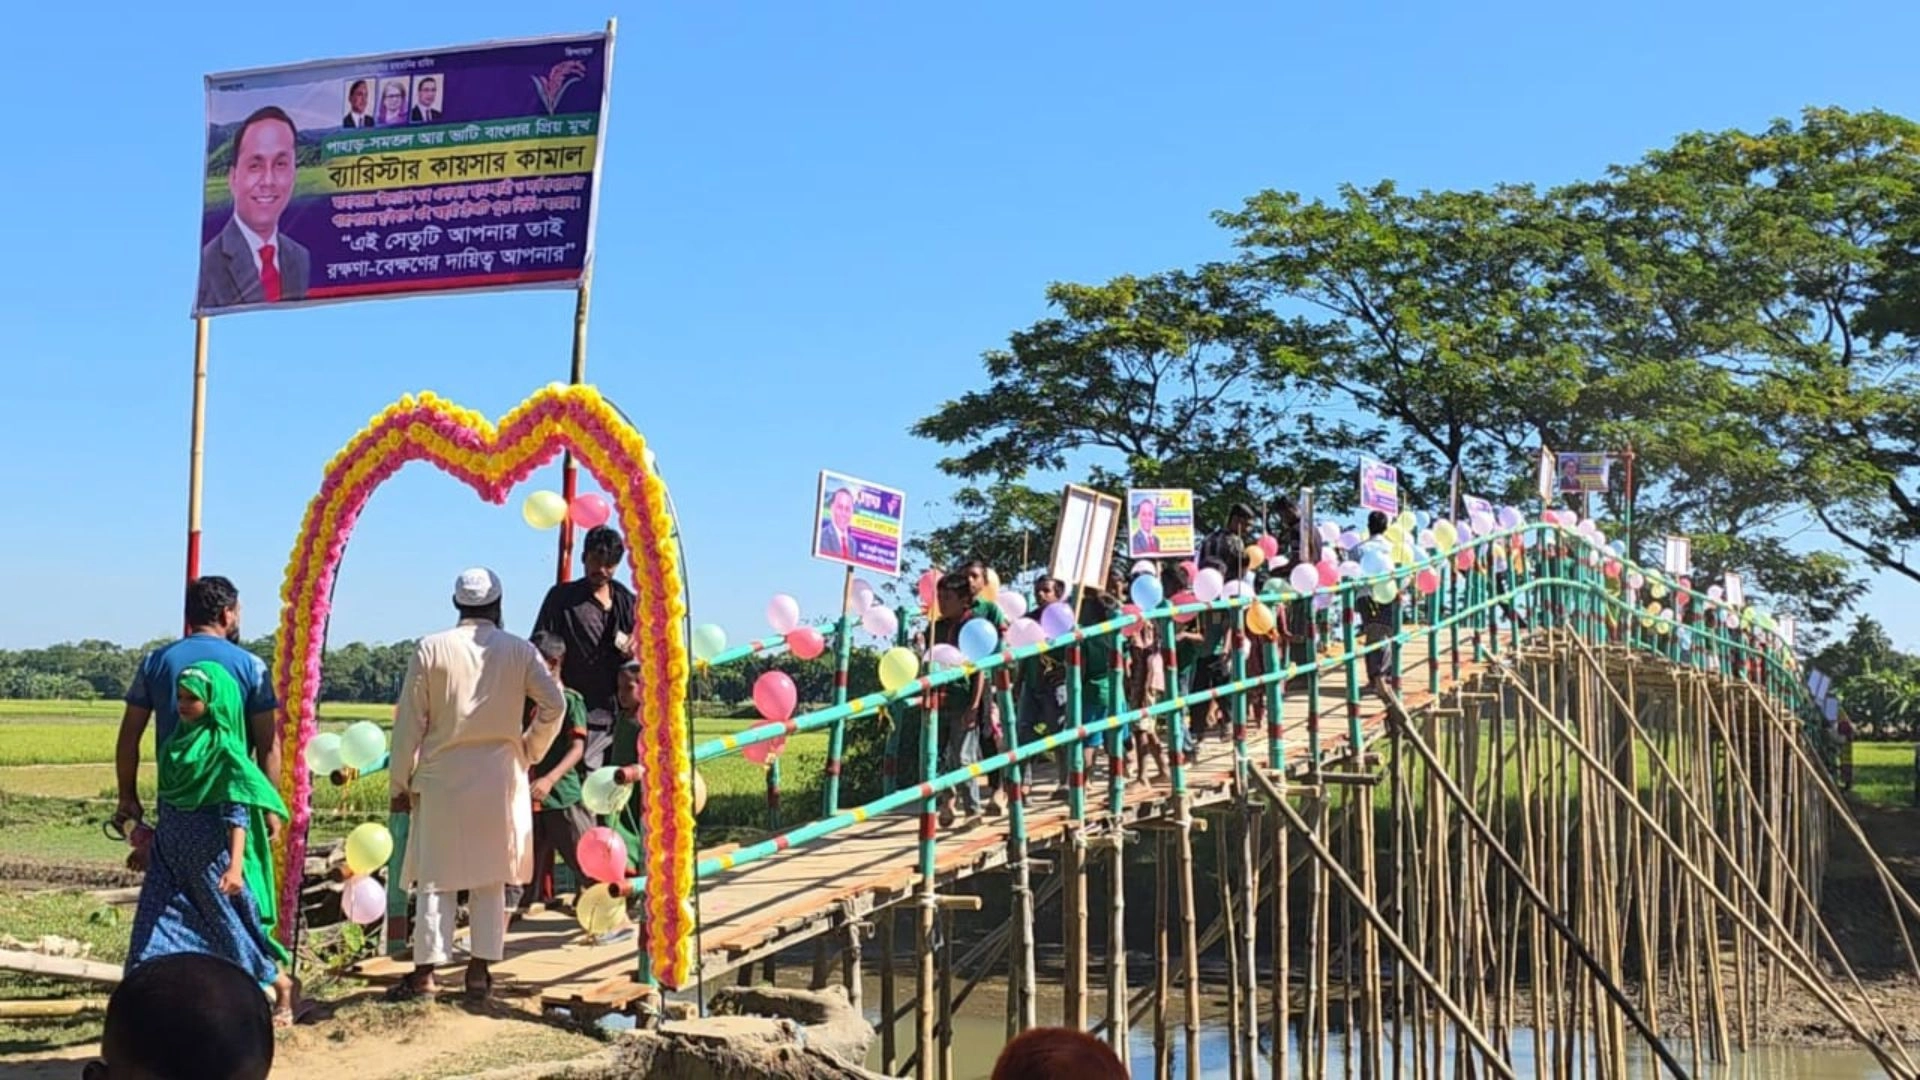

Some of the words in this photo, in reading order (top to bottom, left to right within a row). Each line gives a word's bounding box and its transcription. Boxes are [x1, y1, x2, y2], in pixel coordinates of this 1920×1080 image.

[484, 123, 530, 139] বাংলার
[536, 118, 563, 135] প্রিয়
[327, 155, 422, 188] ব্যারিস্টার
[427, 151, 508, 178] কায়সার
[514, 146, 586, 170] কামাল
[341, 231, 380, 252] “এই
[384, 224, 443, 253] সেতুটি
[446, 223, 520, 243] আপনার
[524, 216, 566, 237] তাই
[326, 254, 441, 279] রক্ষণা-বেক্ষণের
[443, 247, 497, 273] দায়িত্ব
[499, 242, 576, 265] আপনার”
